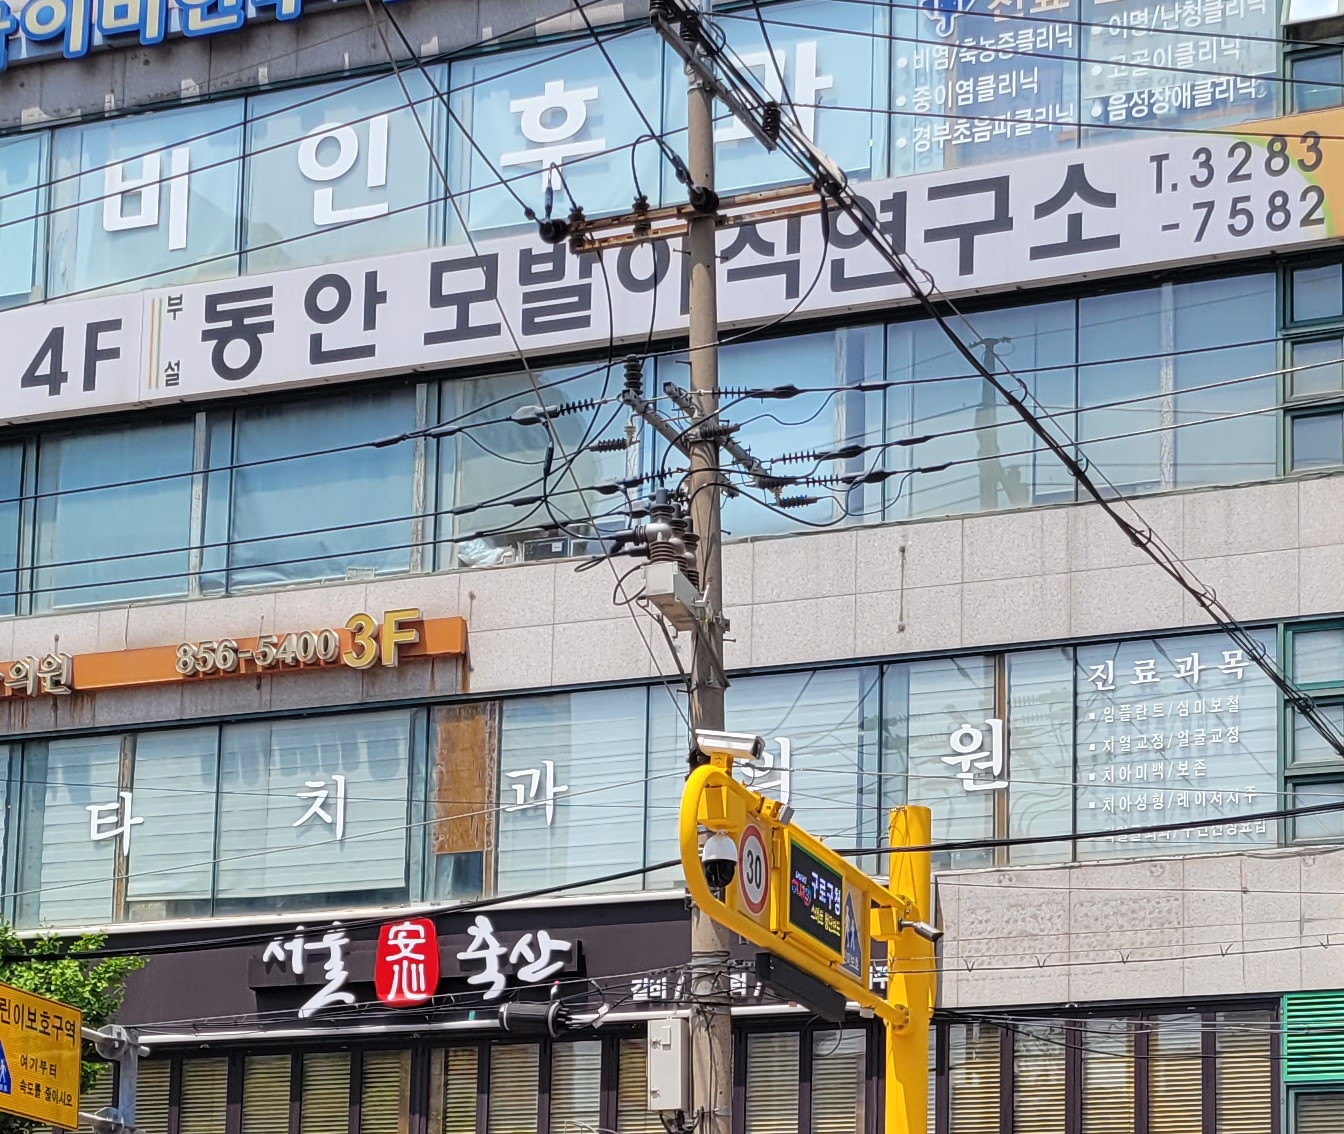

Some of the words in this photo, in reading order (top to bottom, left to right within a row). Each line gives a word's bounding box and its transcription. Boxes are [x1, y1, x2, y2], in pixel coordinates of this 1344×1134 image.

[912, 67, 1040, 113] 중이염클리닉
[1107, 75, 1259, 122] 음성장애클리닉
[1160, 185, 1325, 243] -7582
[20, 318, 123, 397] 4F
[201, 270, 388, 382] 동안
[176, 629, 339, 675] 856-5400
[343, 607, 421, 670] 3F
[1087, 649, 1249, 692] 진료과목
[745, 849, 762, 889] 30
[263, 920, 356, 1018] 서울
[387, 920, 428, 1001] 安心
[456, 915, 572, 999] 축산
[19, 1053, 58, 1080] 여기부터
